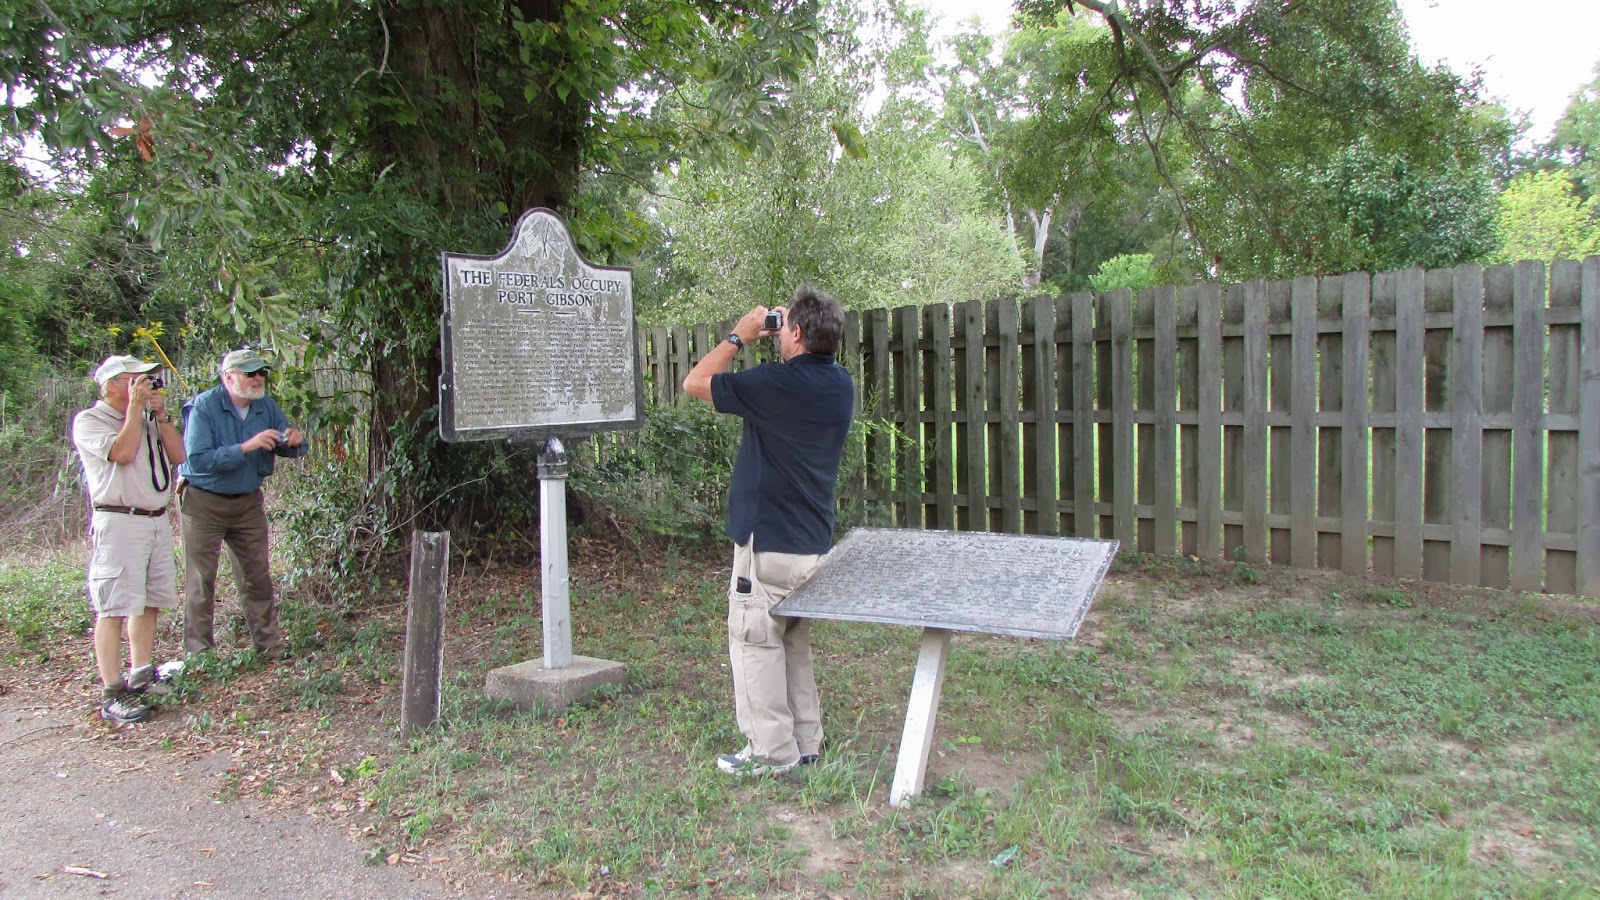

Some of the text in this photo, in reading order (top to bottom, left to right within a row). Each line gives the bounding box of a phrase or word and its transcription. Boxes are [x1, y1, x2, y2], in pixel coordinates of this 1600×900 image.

[461, 269, 622, 292] THE FEDERALS OCCUPY
[498, 290, 594, 307] PORT GIBSON
